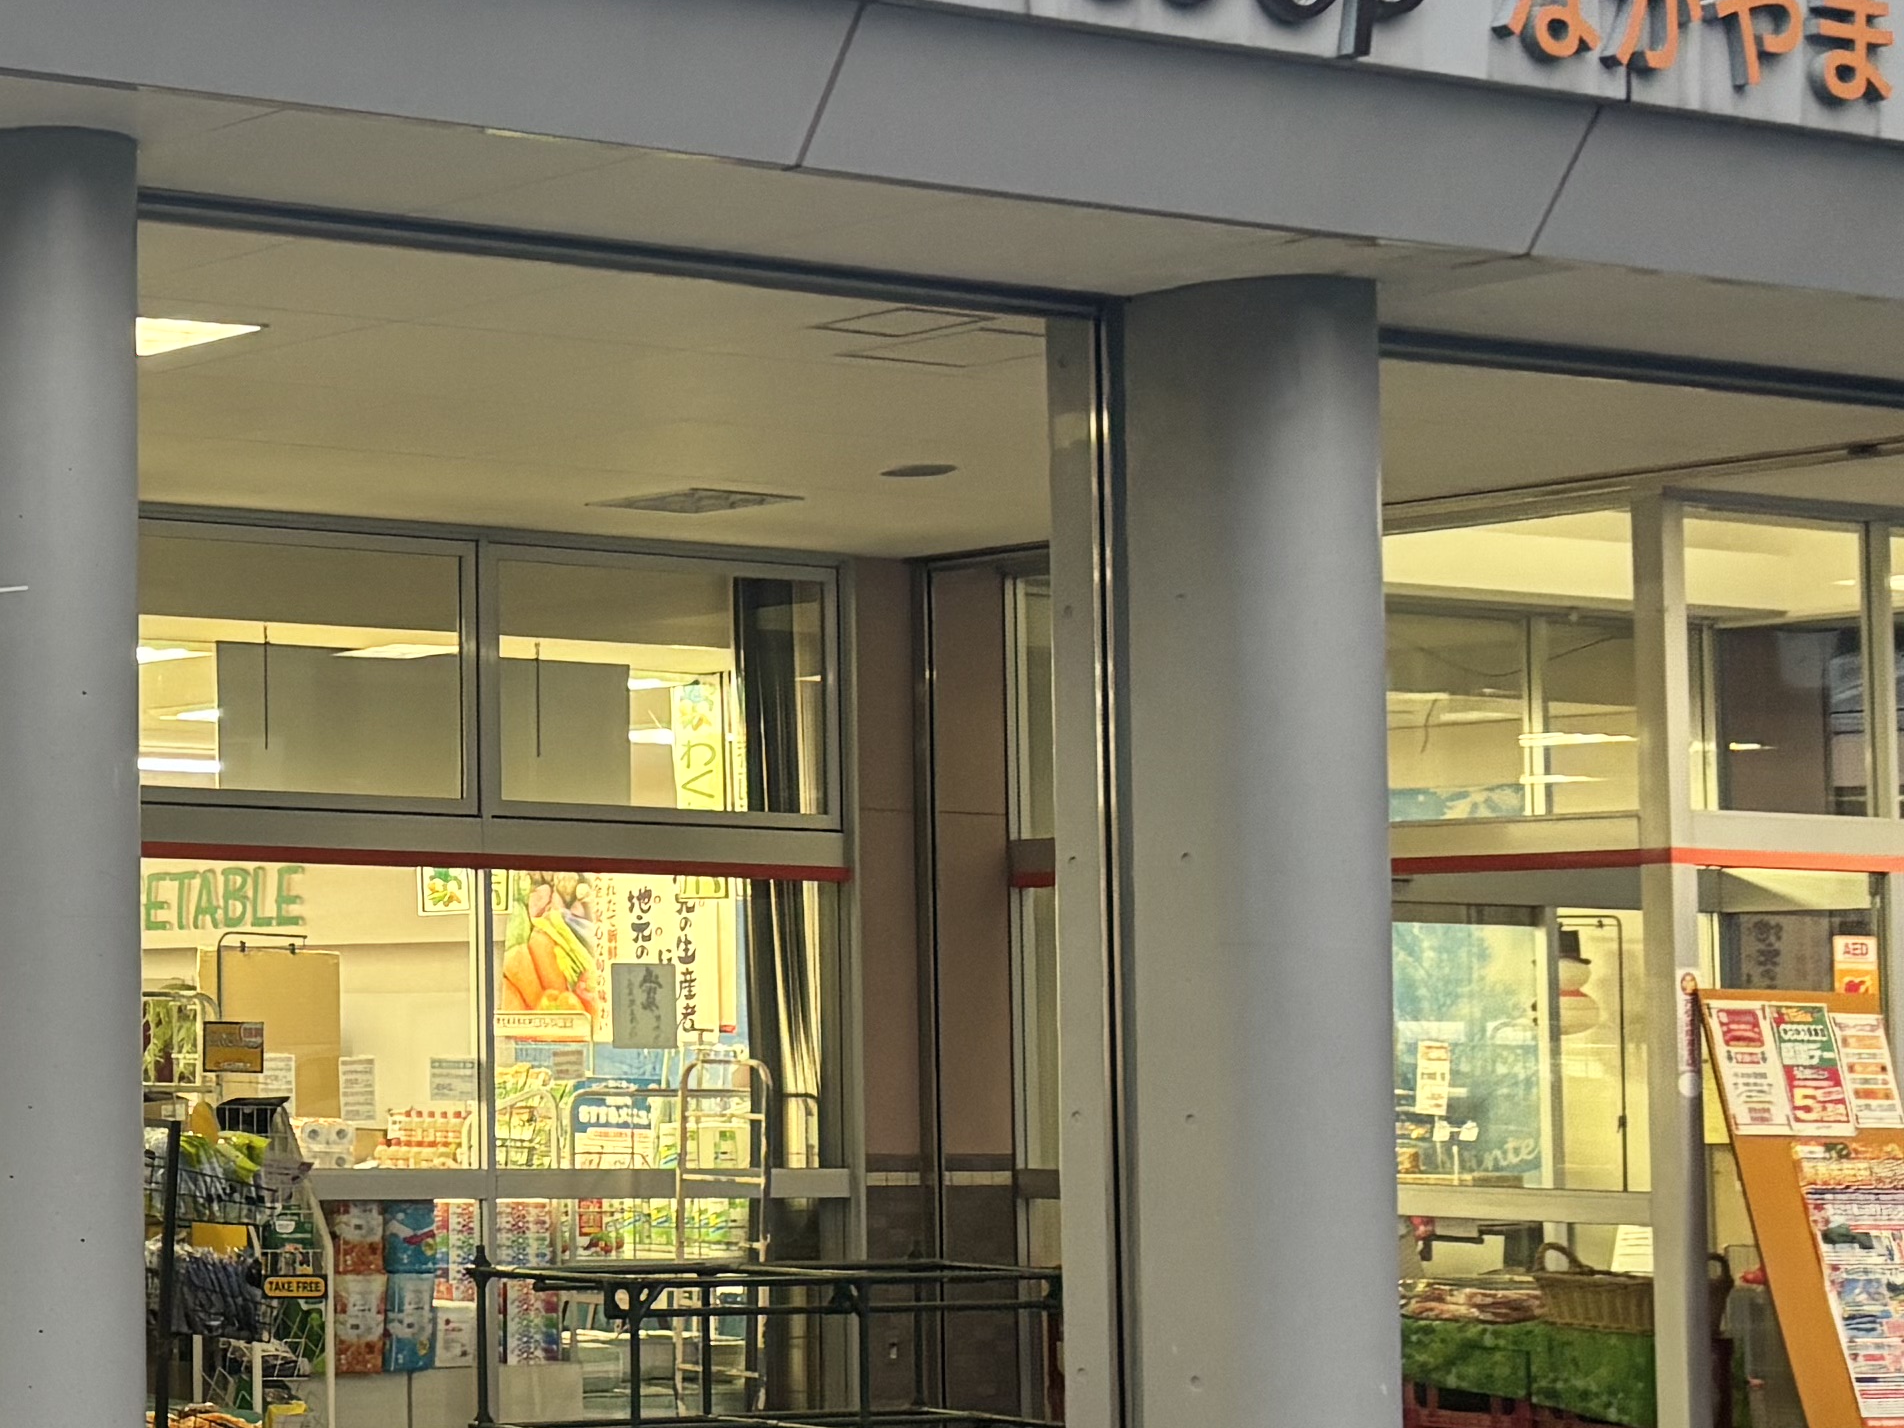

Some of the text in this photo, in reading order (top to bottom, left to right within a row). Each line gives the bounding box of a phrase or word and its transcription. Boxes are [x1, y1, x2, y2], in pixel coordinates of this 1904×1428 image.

[1844, 942, 1869, 957] AED
[268, 1281, 322, 1293] TAKE FREE
